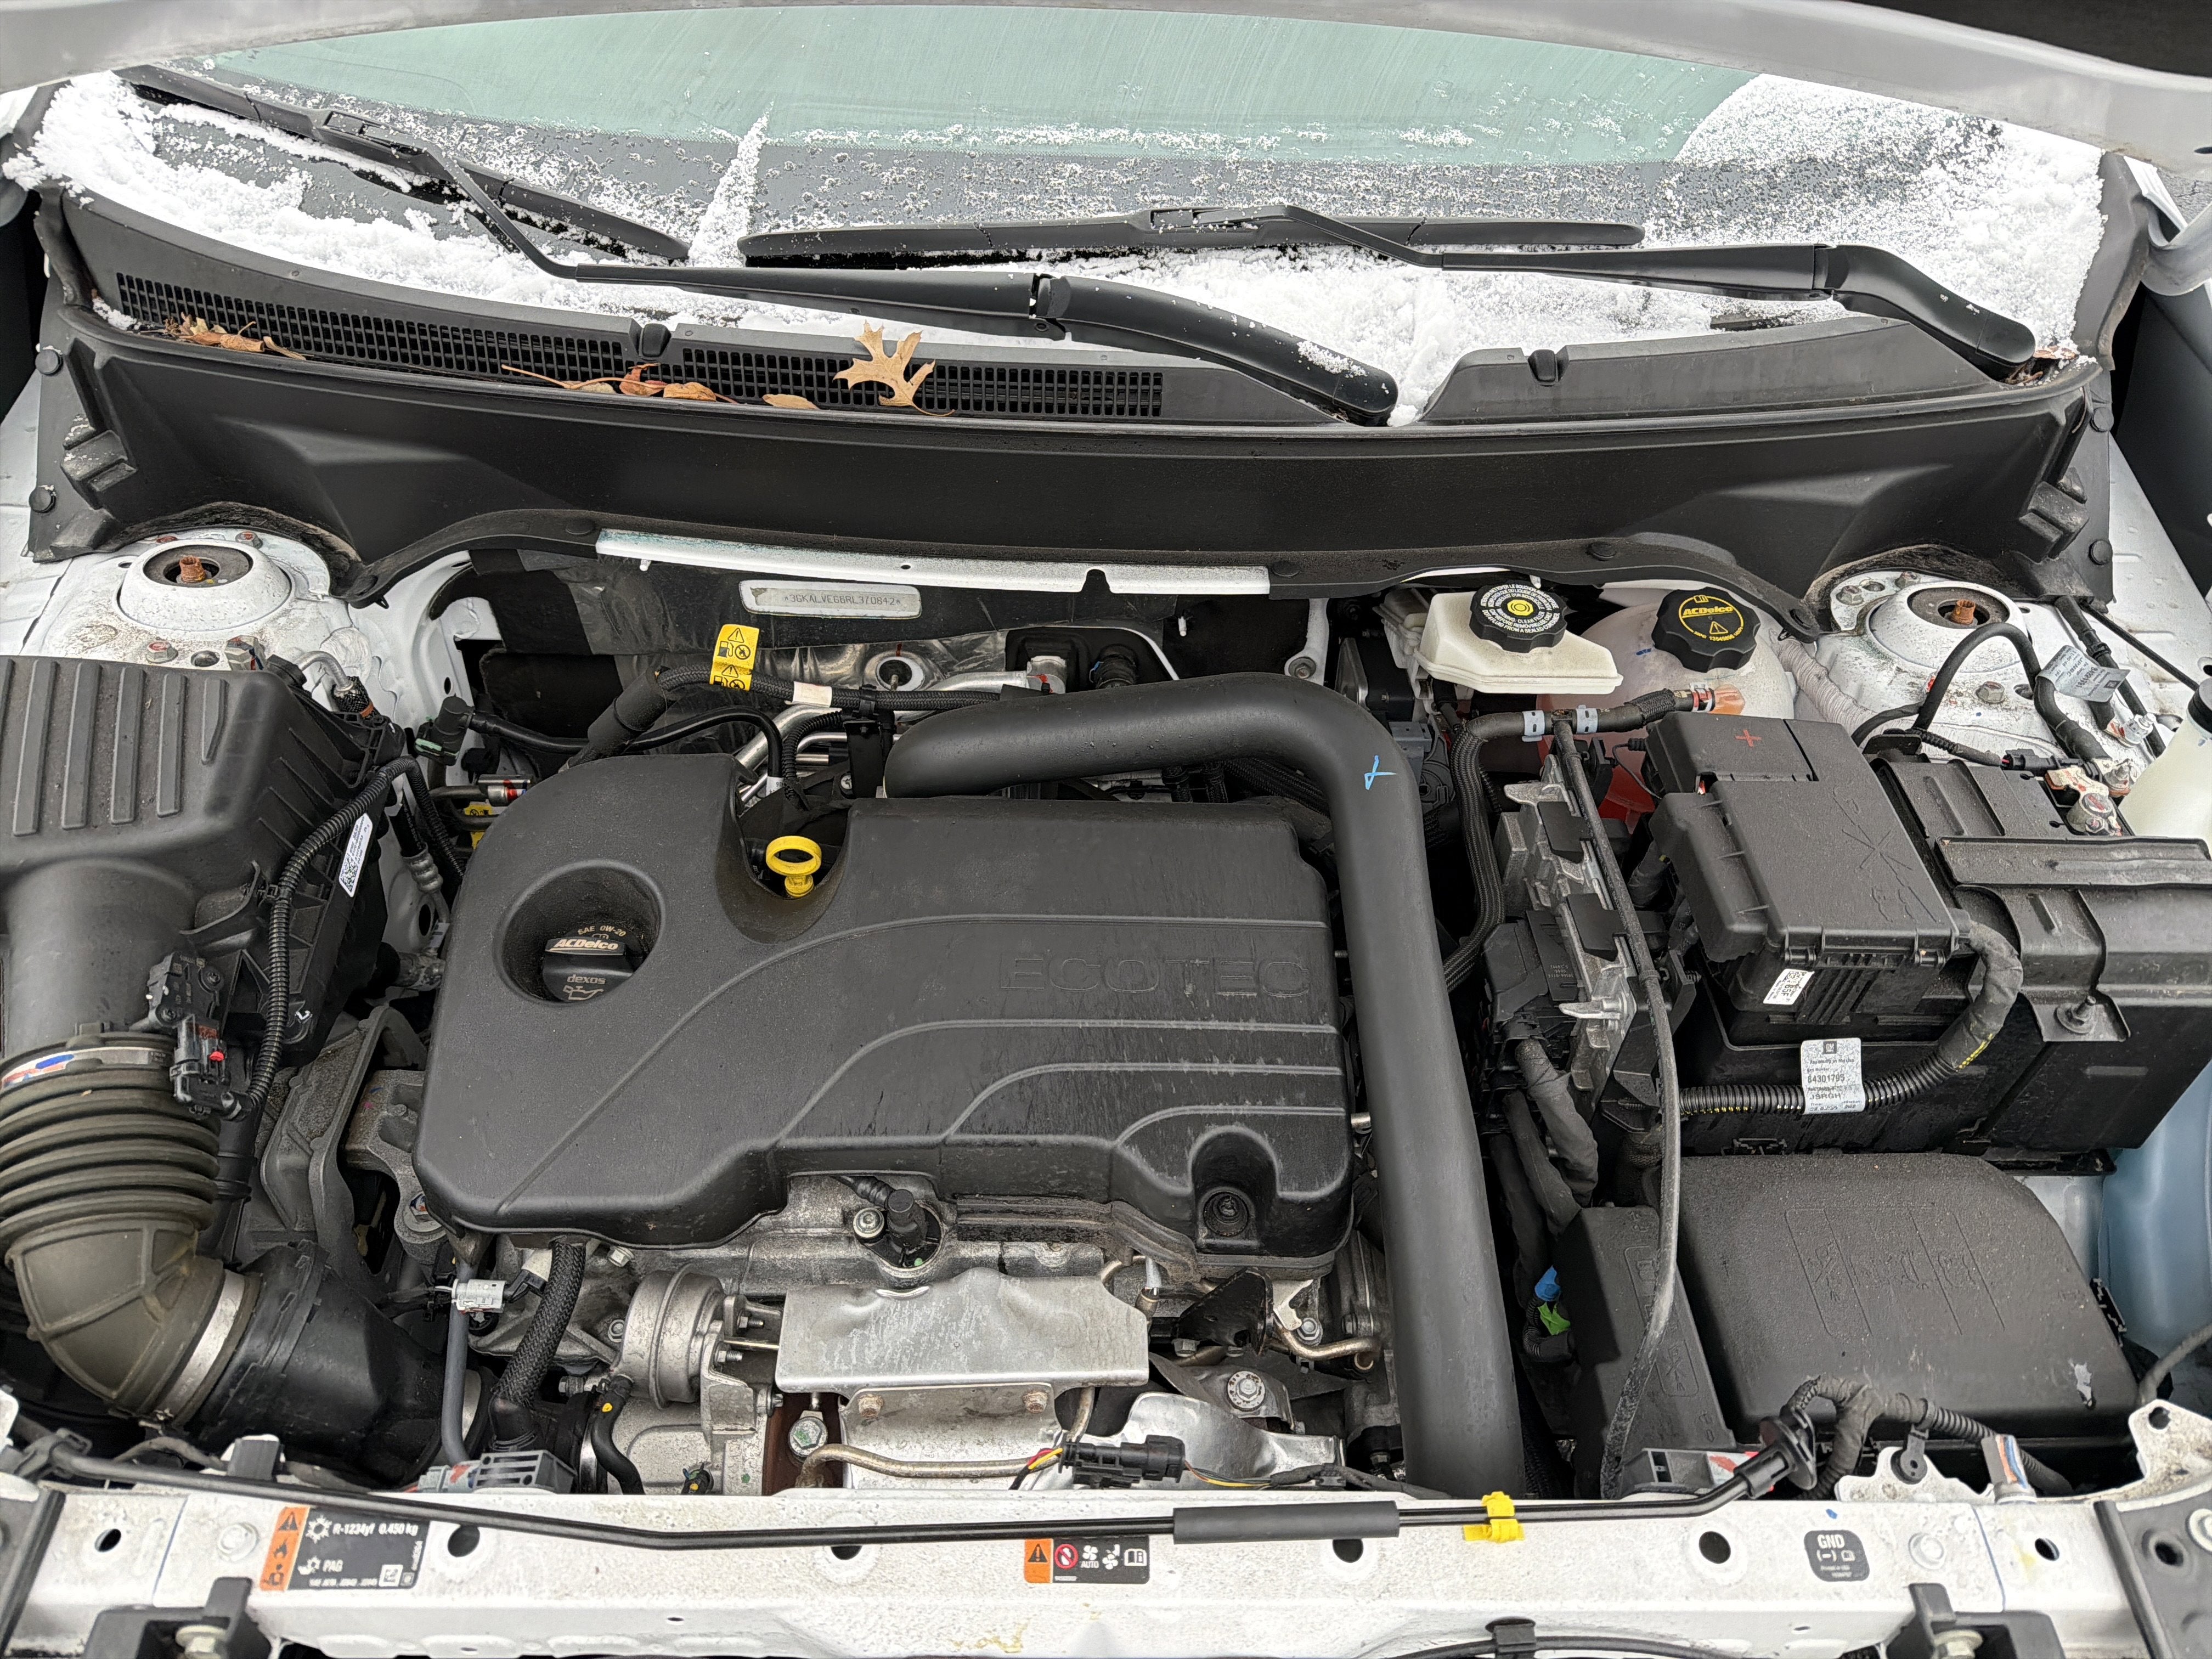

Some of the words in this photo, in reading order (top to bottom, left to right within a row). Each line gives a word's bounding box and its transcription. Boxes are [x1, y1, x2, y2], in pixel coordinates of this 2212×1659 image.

[1683, 606, 1734, 616] ACDelco
[578, 926, 595, 935] SAE
[600, 925, 626, 937] 0W-20
[554, 939, 619, 950] ACDelco
[567, 974, 606, 985] dexos
[1000, 955, 1311, 998] ECOTEC
[1808, 1074, 1846, 1084] 84301795
[332, 1523, 375, 1537] R-1234yf
[405, 1523, 419, 1537] kg
[1817, 1534, 1845, 1549] GND
[323, 1559, 343, 1572] PAG
